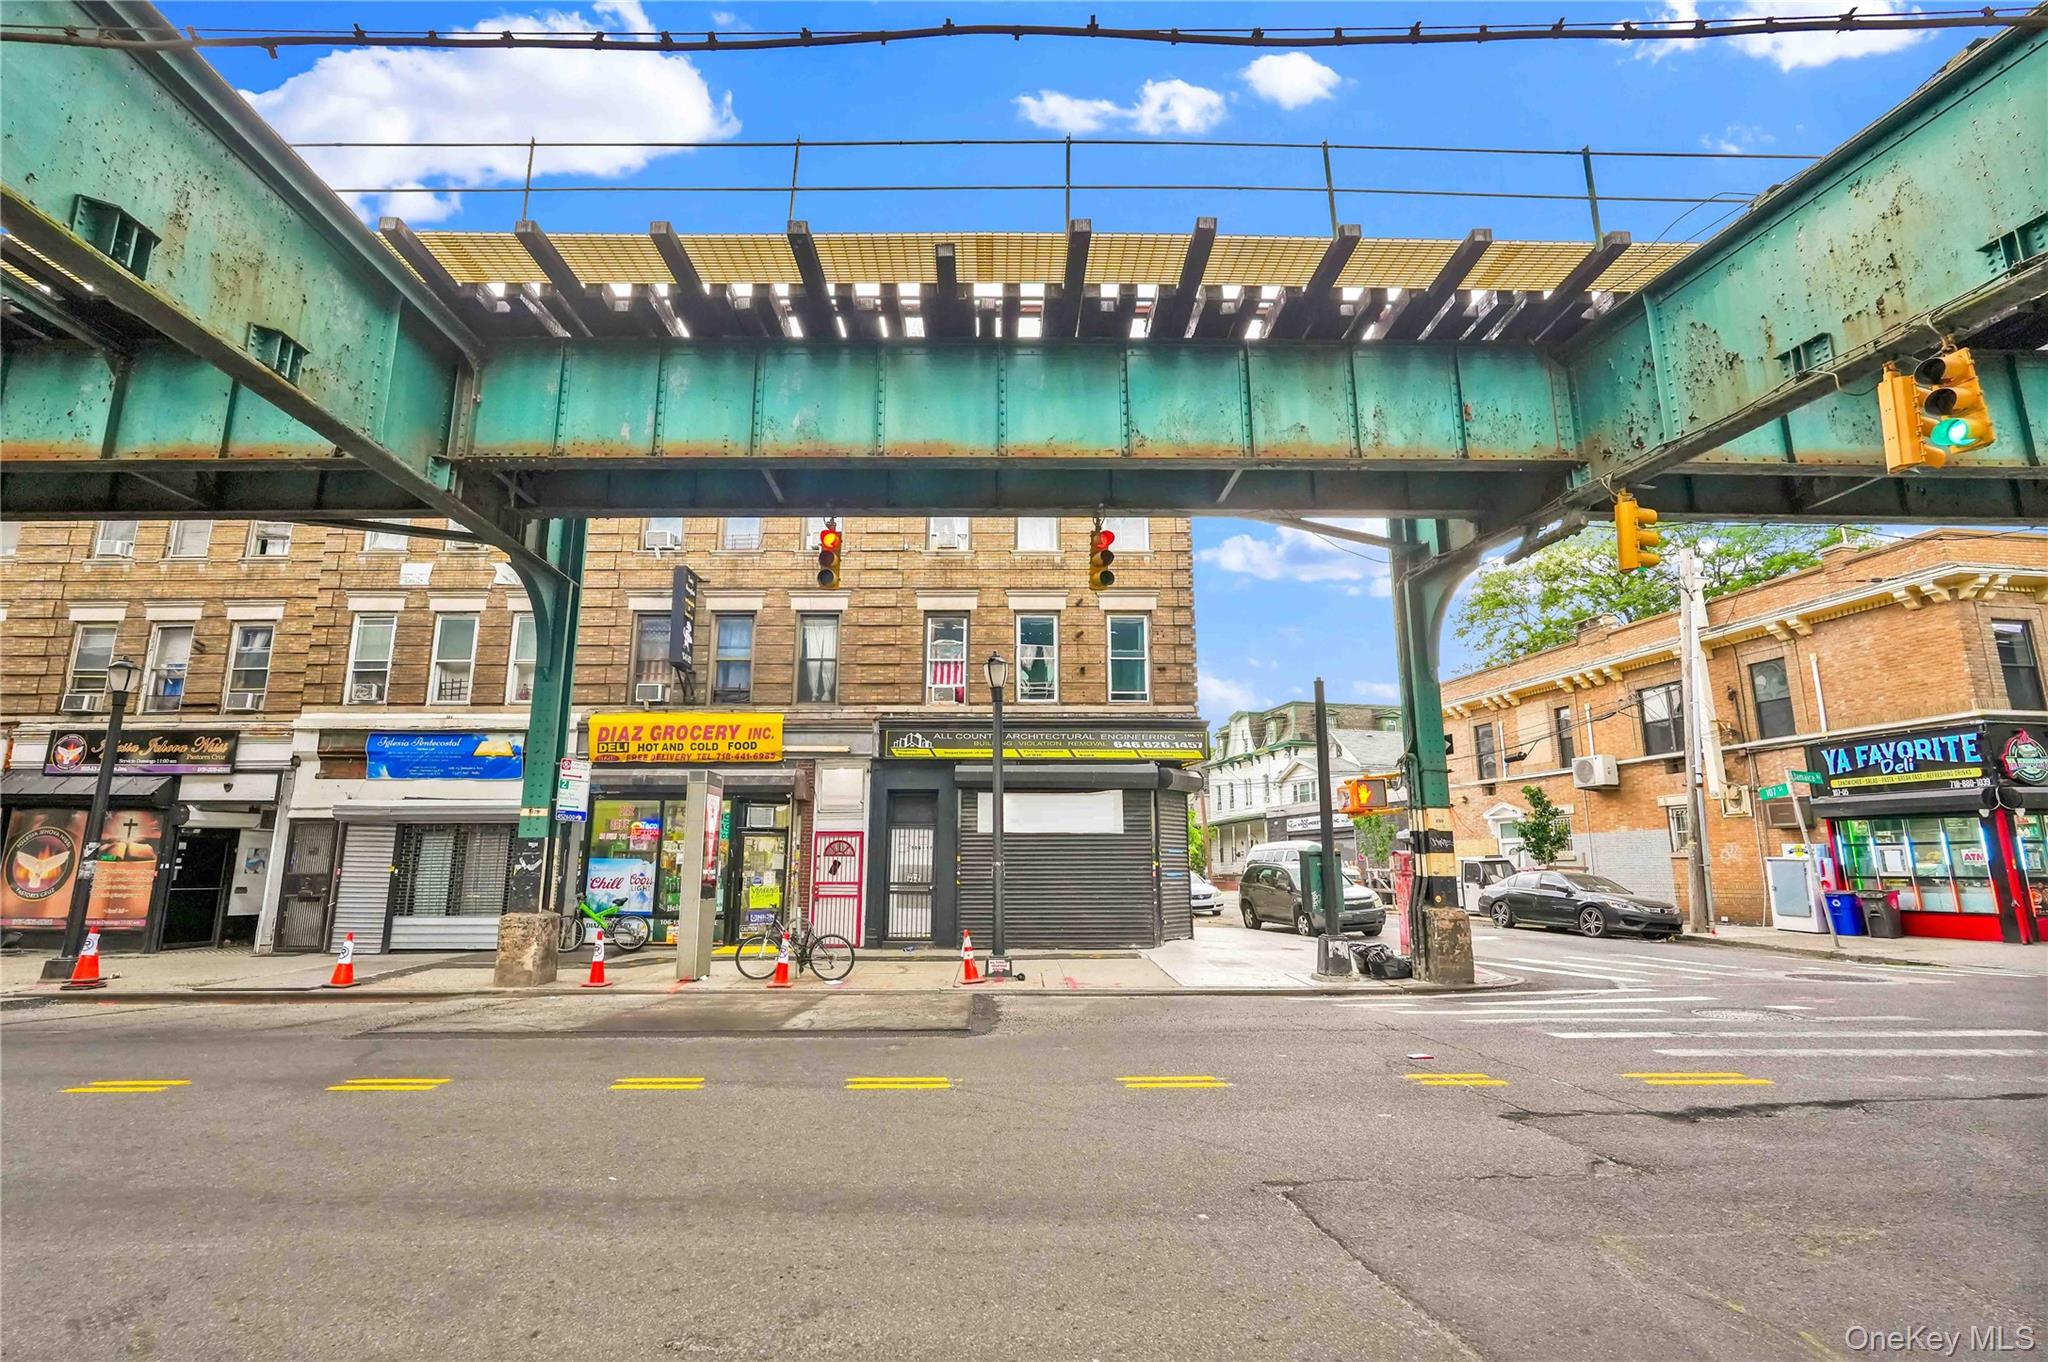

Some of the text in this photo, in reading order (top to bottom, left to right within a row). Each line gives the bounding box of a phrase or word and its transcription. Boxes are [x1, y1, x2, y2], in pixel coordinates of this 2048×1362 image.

[597, 725, 775, 742] DIAZ GROCERY INC.
[410, 737, 462, 748] Pentecostal
[599, 743, 628, 752] DELI
[637, 742, 757, 752] HOT AND COLD FOOD
[626, 753, 649, 761] FREE
[1821, 748, 1853, 775] YA
[1855, 733, 1983, 769] FAVORITE
[1880, 757, 1915, 775] Deli
[1955, 769, 1972, 777] DRINKS
[561, 781, 568, 790] 2
[1765, 787, 1776, 797] 107
[589, 877, 625, 890] Chill
[629, 873, 653, 886] Coors
